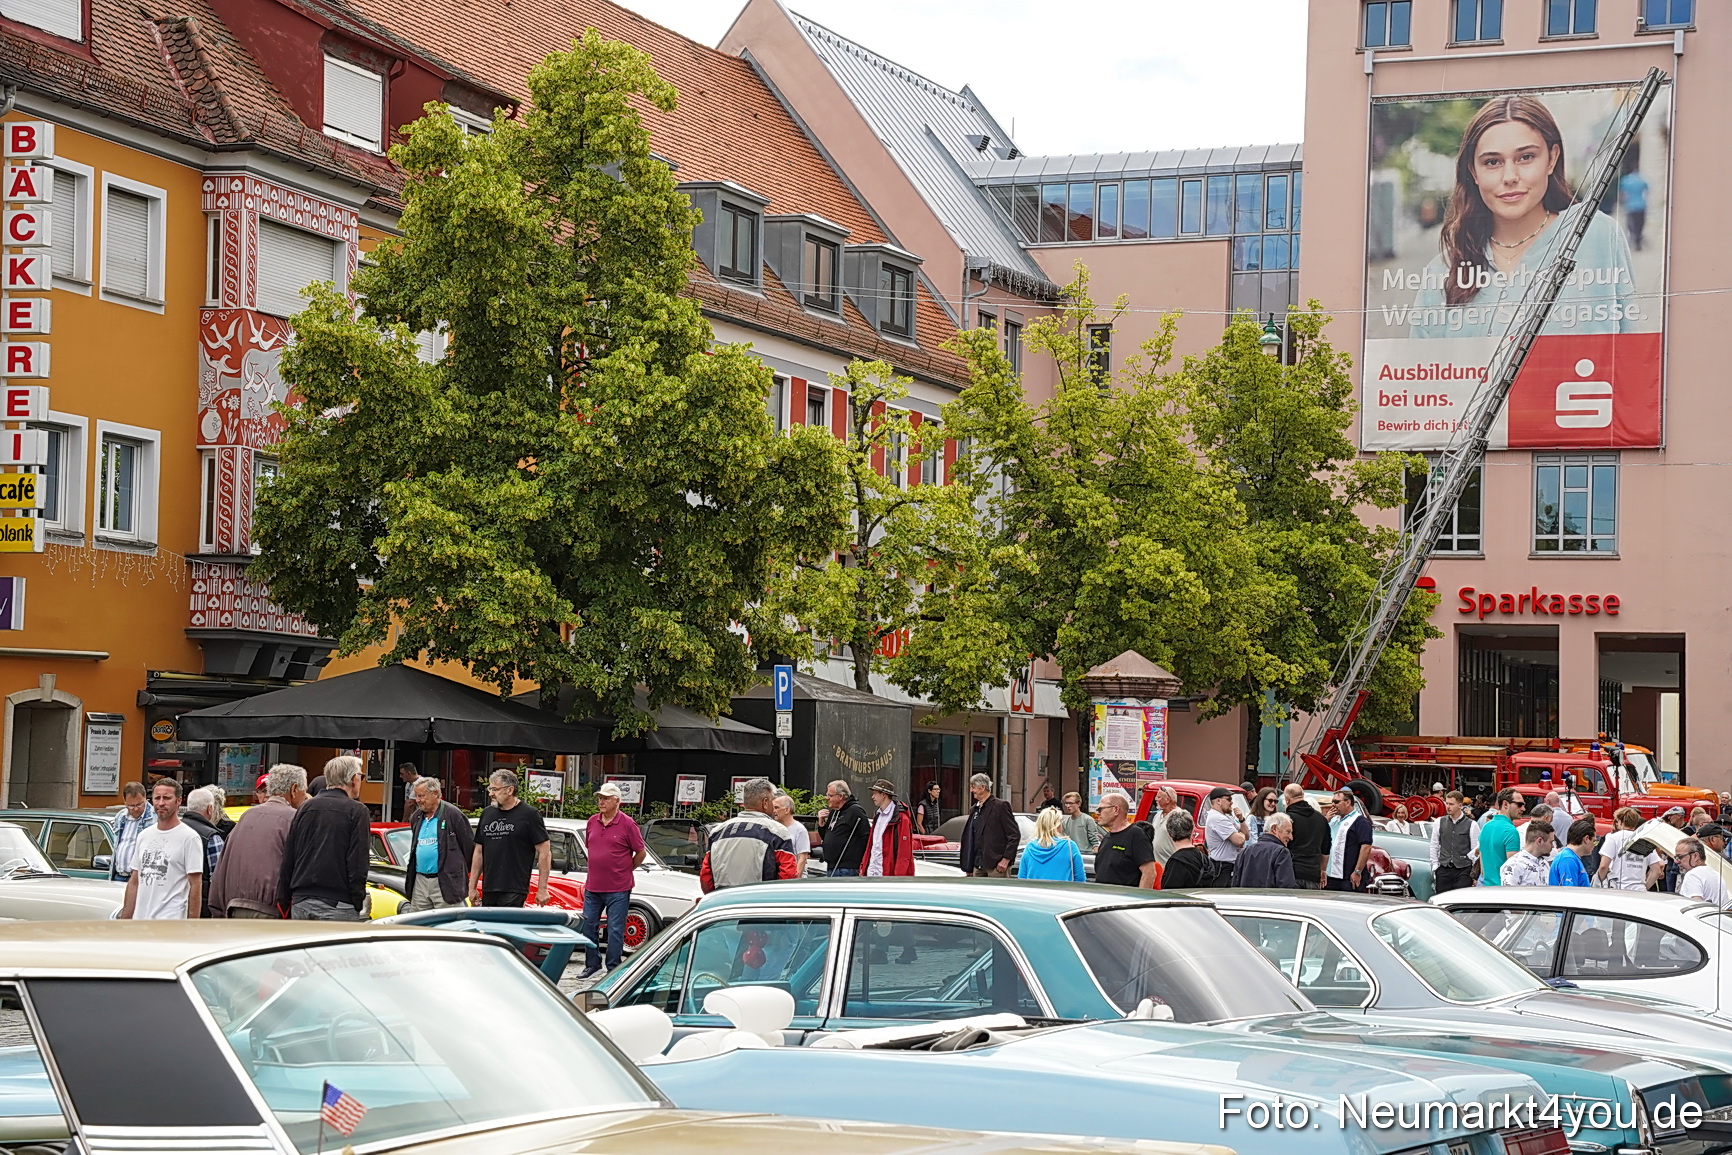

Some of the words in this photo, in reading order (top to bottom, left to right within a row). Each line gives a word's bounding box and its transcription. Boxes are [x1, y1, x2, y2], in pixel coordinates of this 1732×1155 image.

[1383, 266, 1450, 291] Mehr
[1456, 260, 1631, 292] Überhspur.
[6, 125, 37, 461] BÄCKEREI
[1381, 302, 1492, 331] Weniger
[1500, 301, 1649, 329] Sakgasse.
[1378, 363, 1489, 384] Ausbildung
[1378, 389, 1408, 407] bei
[1413, 393, 1454, 407] uns.
[1377, 420, 1420, 432] Bewirb
[1423, 419, 1449, 432] dich
[0, 476, 35, 502] café
[1457, 586, 1621, 620] Sparkasse
[778, 671, 789, 705] P
[835, 745, 893, 774] BRATWURSTHAUS
